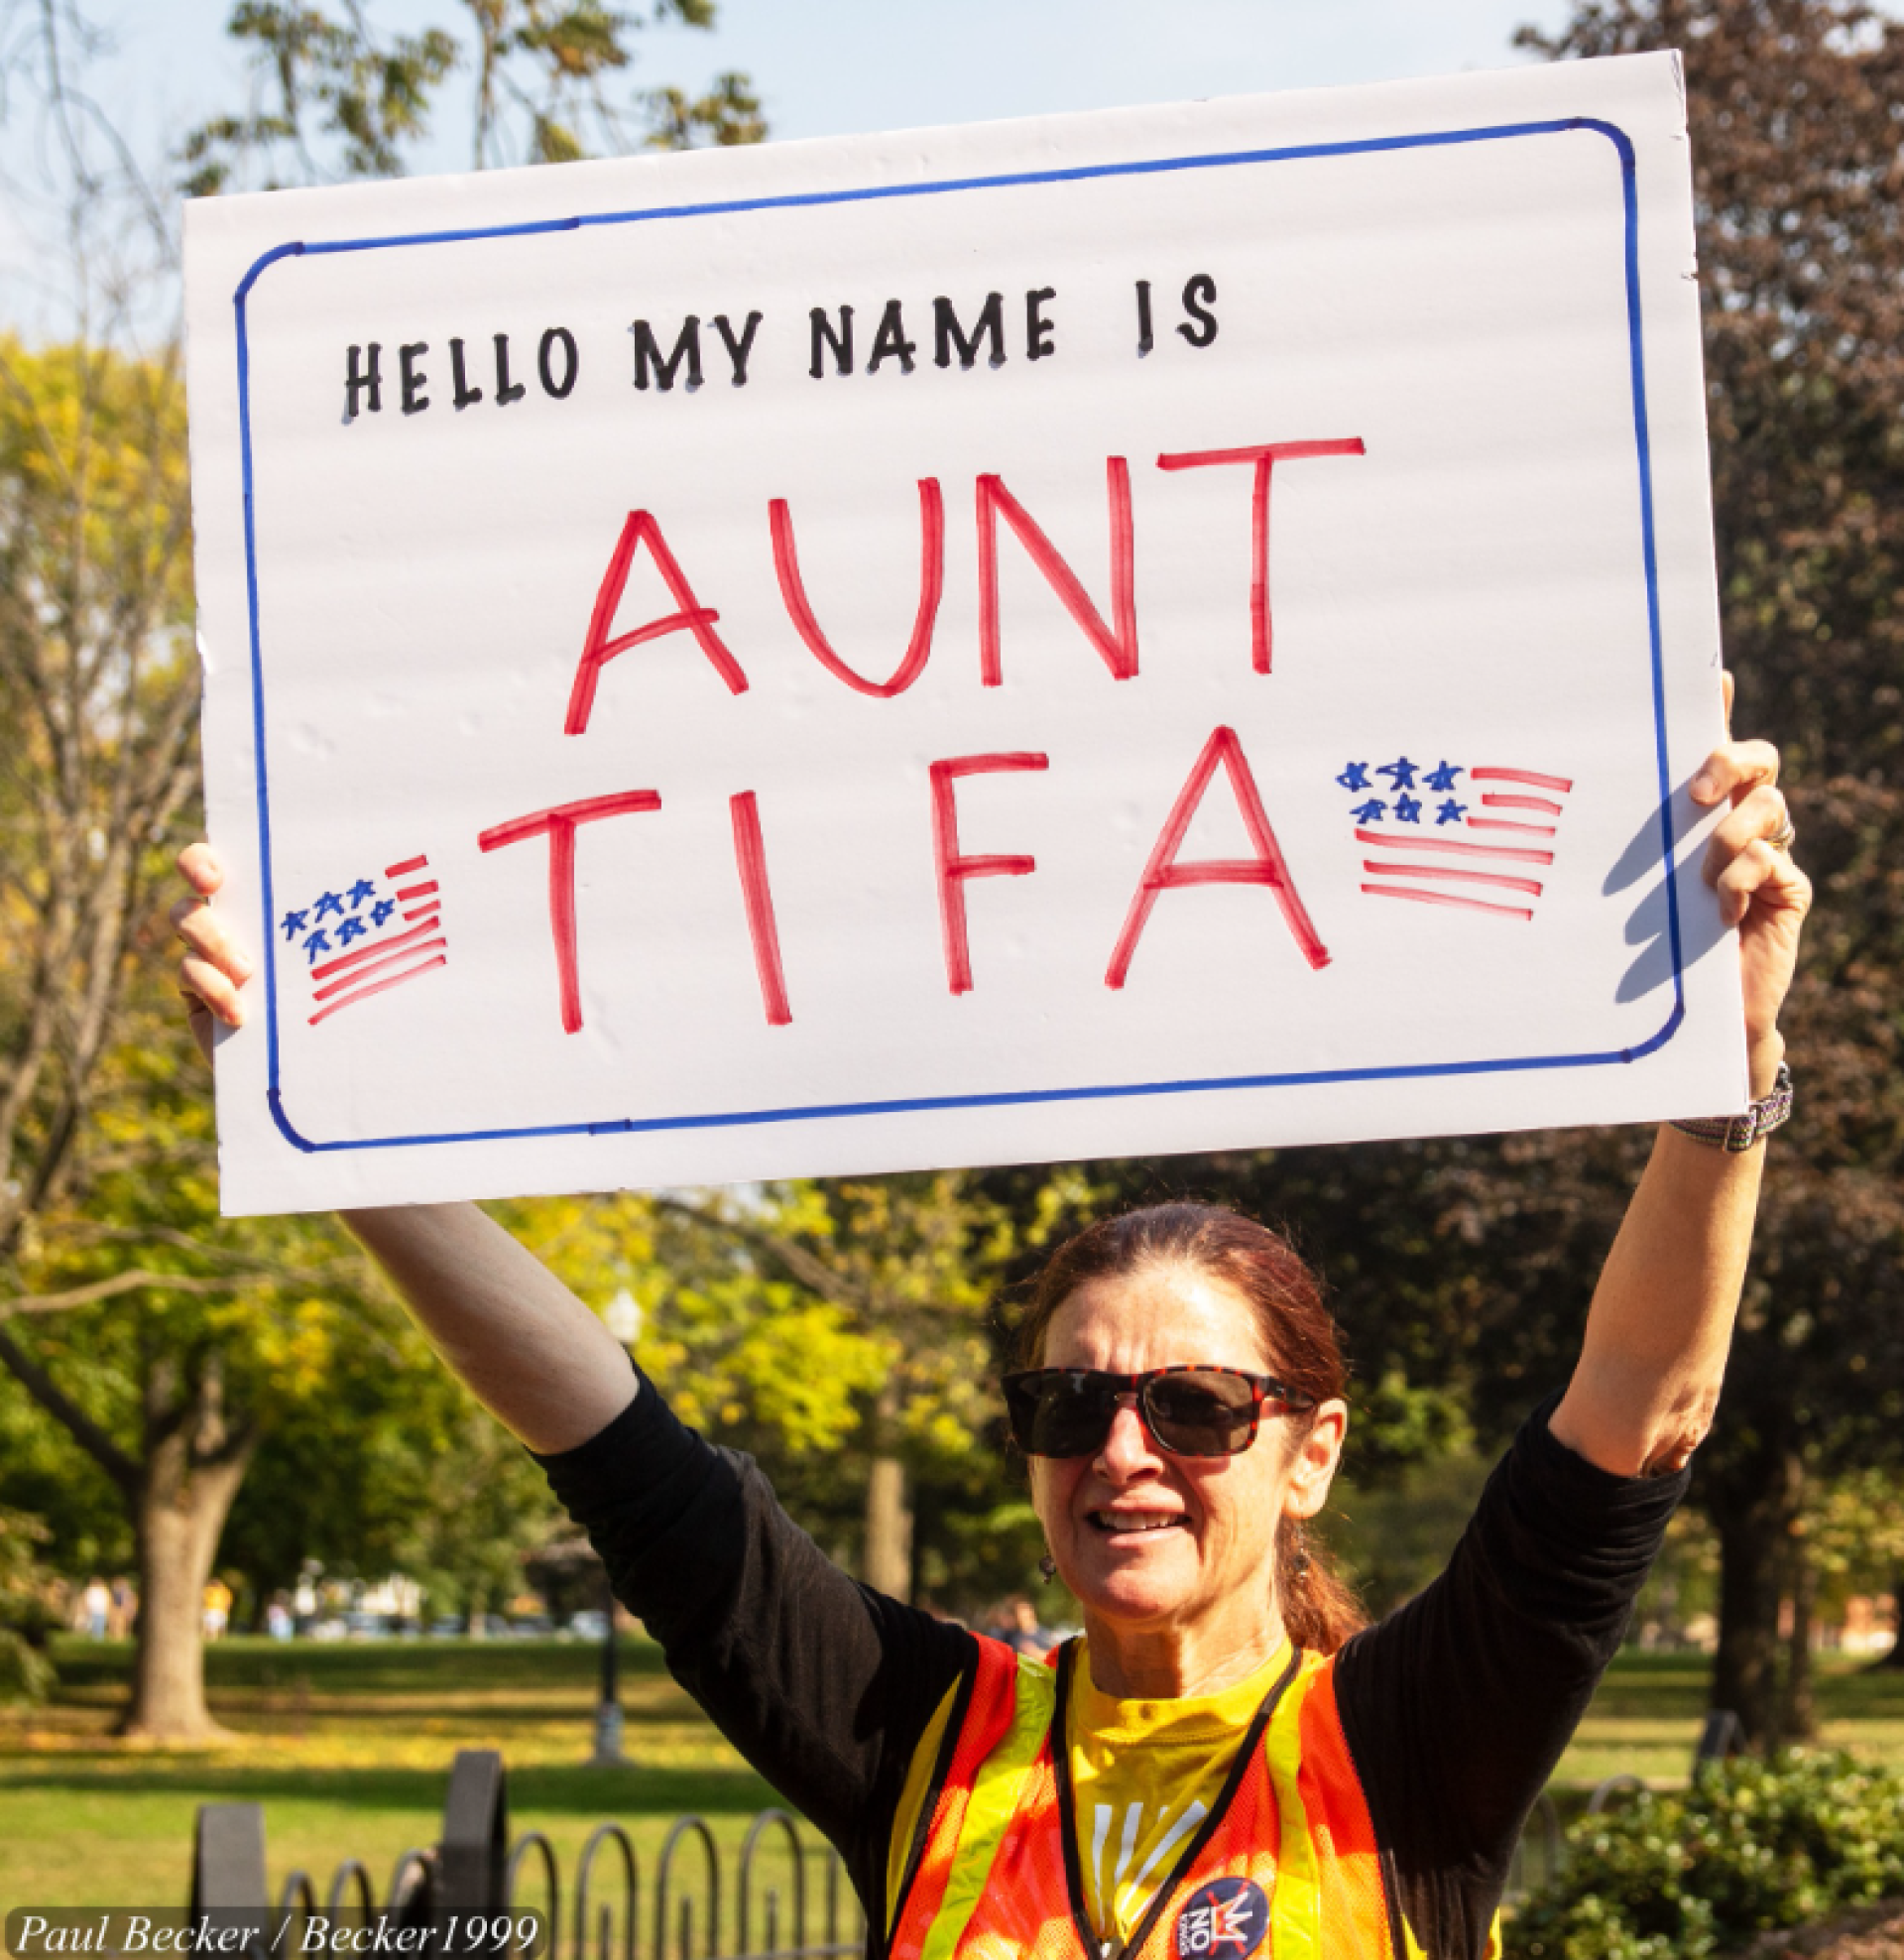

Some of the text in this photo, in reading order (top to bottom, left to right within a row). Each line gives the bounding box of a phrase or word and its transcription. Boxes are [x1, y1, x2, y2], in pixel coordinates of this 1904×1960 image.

[344, 274, 1220, 421] HELLO MY NAME IS
[563, 435, 1367, 736] AUNT
[1190, 1906, 1210, 1951] NO
